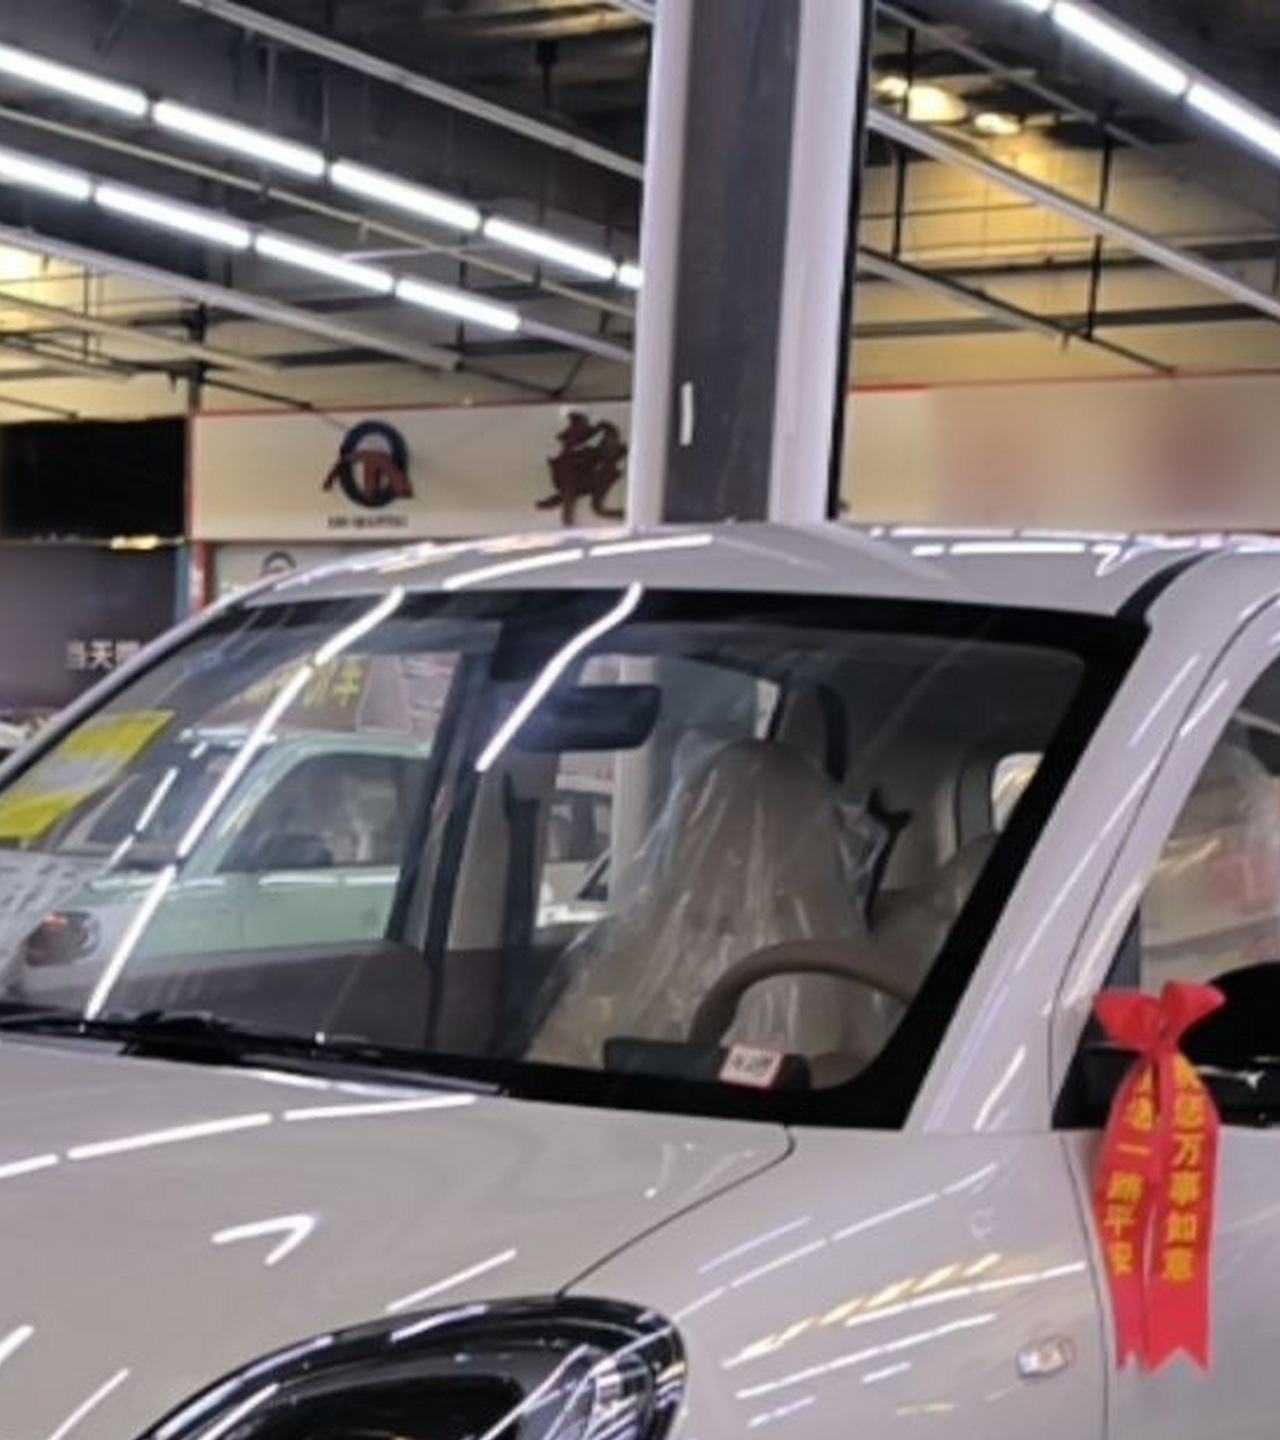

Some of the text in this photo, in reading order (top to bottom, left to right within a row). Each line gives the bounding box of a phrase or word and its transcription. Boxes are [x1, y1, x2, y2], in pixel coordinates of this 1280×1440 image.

[1104, 1066, 1153, 1276] 您一路平安
